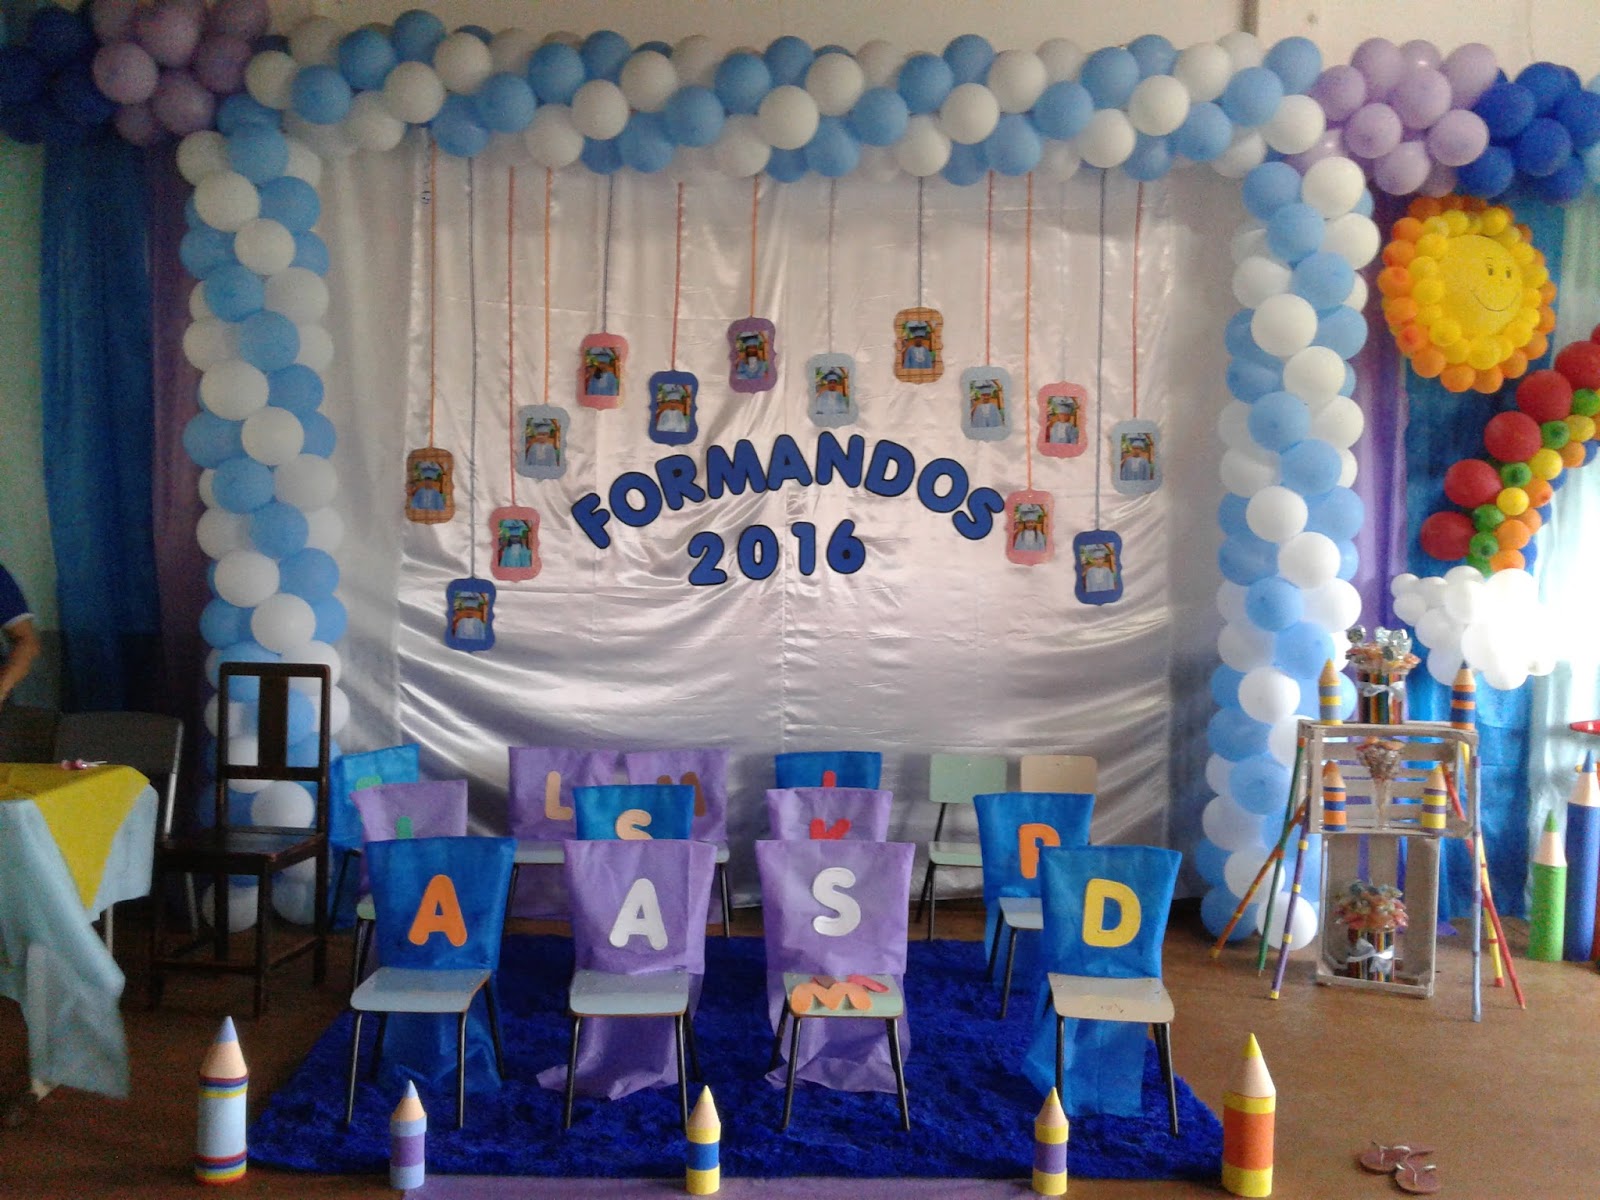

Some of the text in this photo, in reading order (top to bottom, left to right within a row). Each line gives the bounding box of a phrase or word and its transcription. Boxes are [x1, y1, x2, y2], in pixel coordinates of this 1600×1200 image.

[571, 431, 1005, 549] FORMANDOS
[688, 519, 866, 586] 2016
[545, 770, 573, 820] L
[407, 874, 468, 947] A
[609, 878, 668, 950] A
[812, 867, 861, 936] S
[1082, 878, 1141, 947] D
